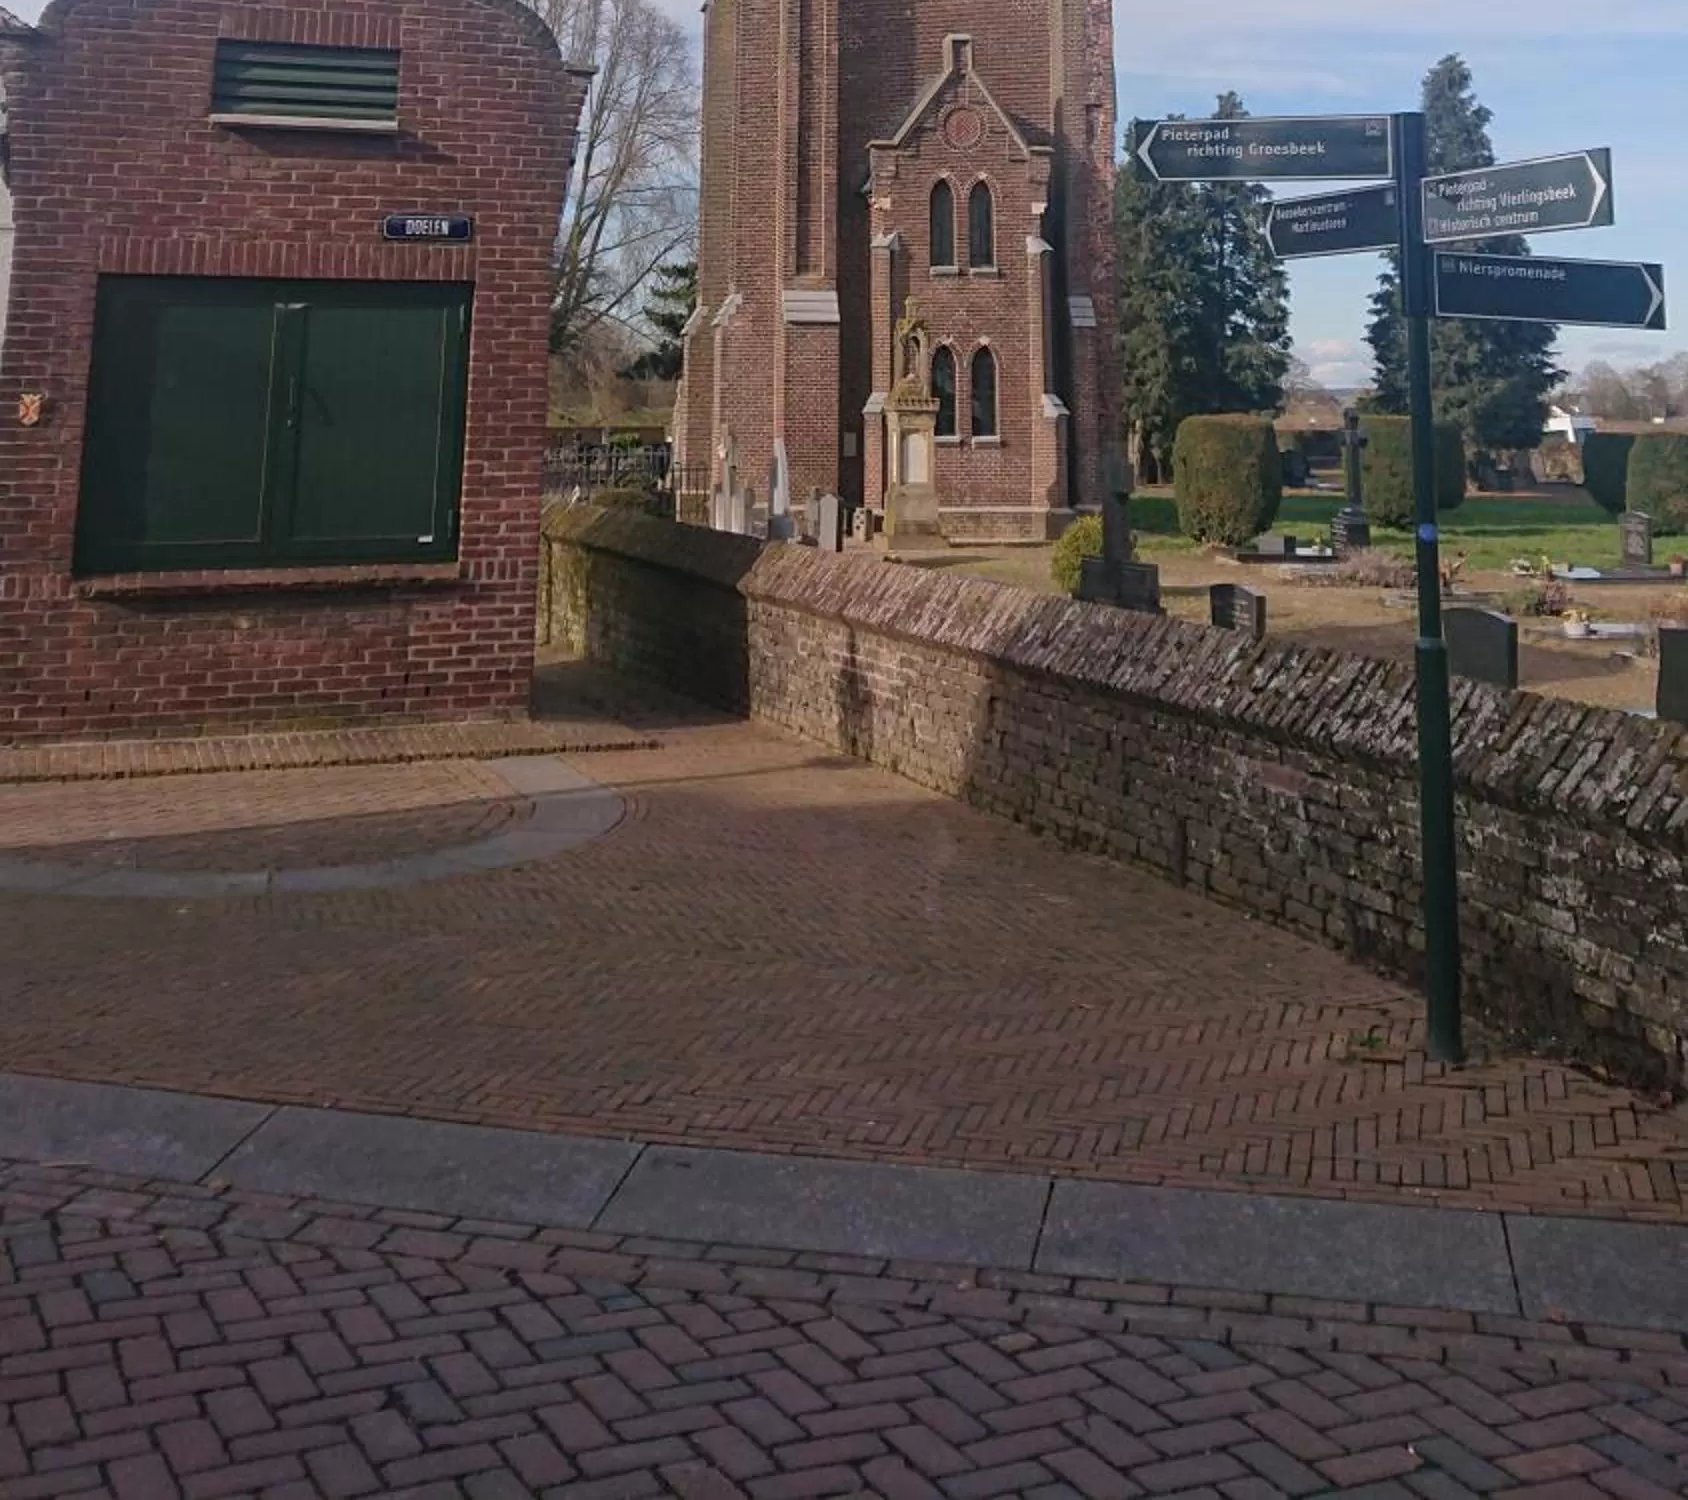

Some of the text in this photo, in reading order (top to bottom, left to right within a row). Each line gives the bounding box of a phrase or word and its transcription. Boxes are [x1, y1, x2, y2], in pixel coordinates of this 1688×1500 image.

[1160, 126, 1230, 143] Pieterpad
[1186, 141, 1326, 160] richting Groesbeek
[1438, 178, 1487, 197] Pieterpad
[1457, 183, 1577, 212] richting Vierlingsbeek
[405, 219, 450, 236] DOELEN
[1438, 210, 1540, 234] Historisch centrum
[1459, 260, 1567, 281] Nierspromenade
